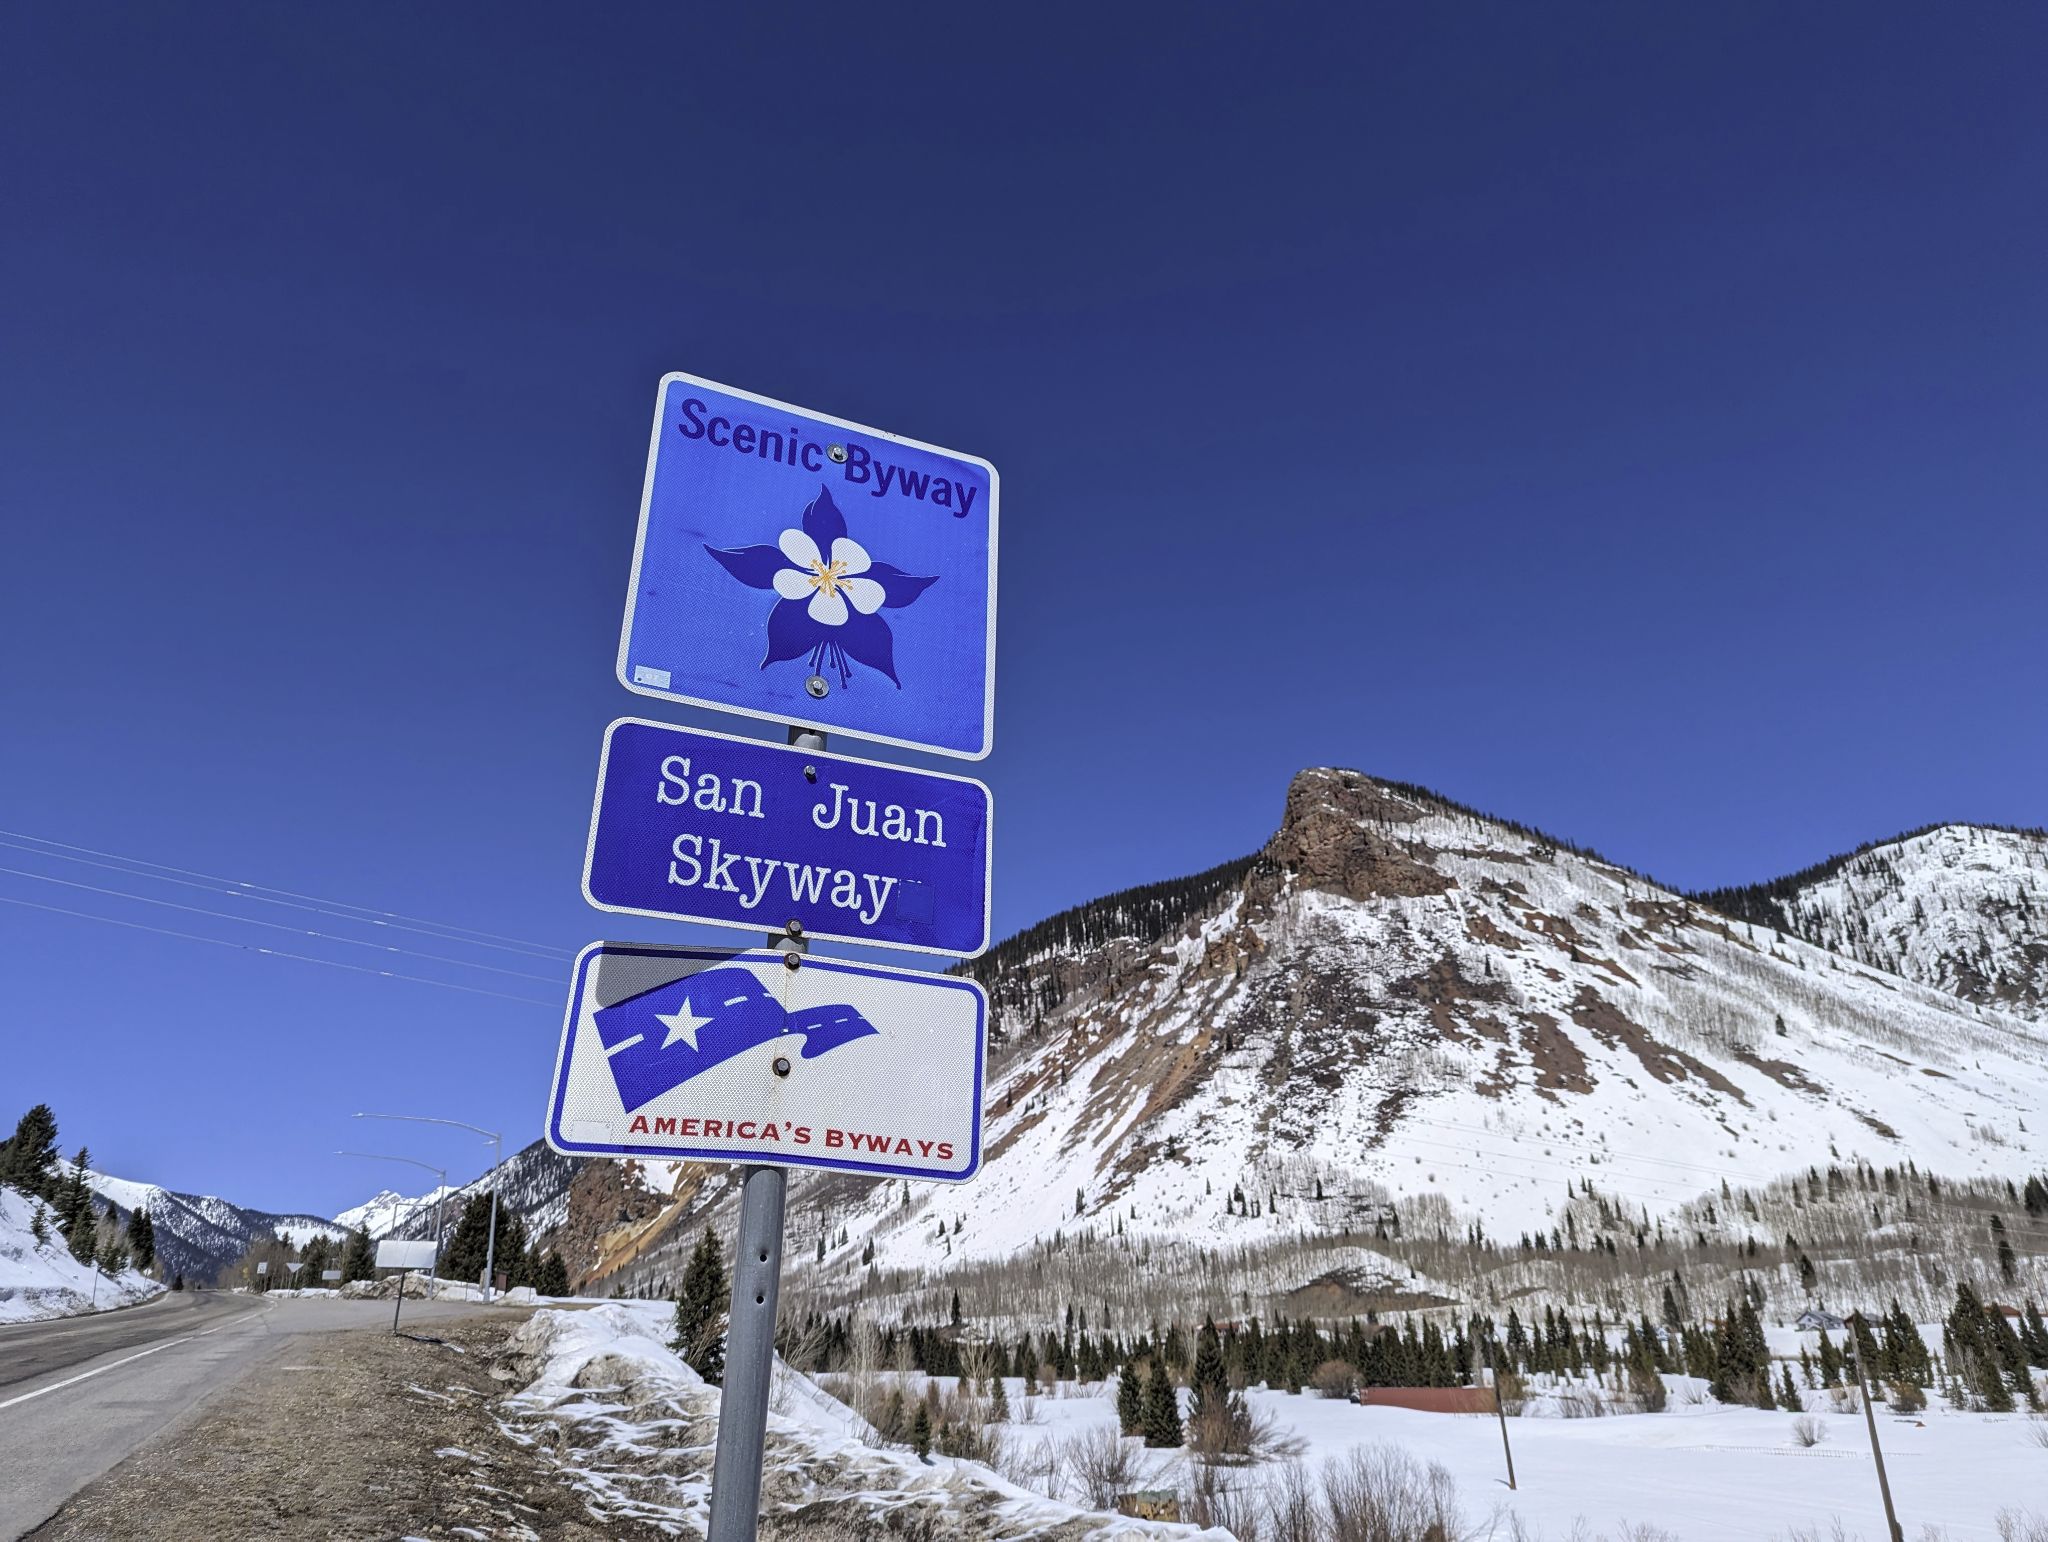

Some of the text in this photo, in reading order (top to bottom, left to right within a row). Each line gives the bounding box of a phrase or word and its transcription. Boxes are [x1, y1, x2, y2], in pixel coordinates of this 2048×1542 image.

[679, 398, 977, 518] Scenic Byway
[656, 755, 947, 848] San Juan
[667, 833, 897, 926] Skyway
[629, 1115, 954, 1160] AMERICA'S BYWAYS
